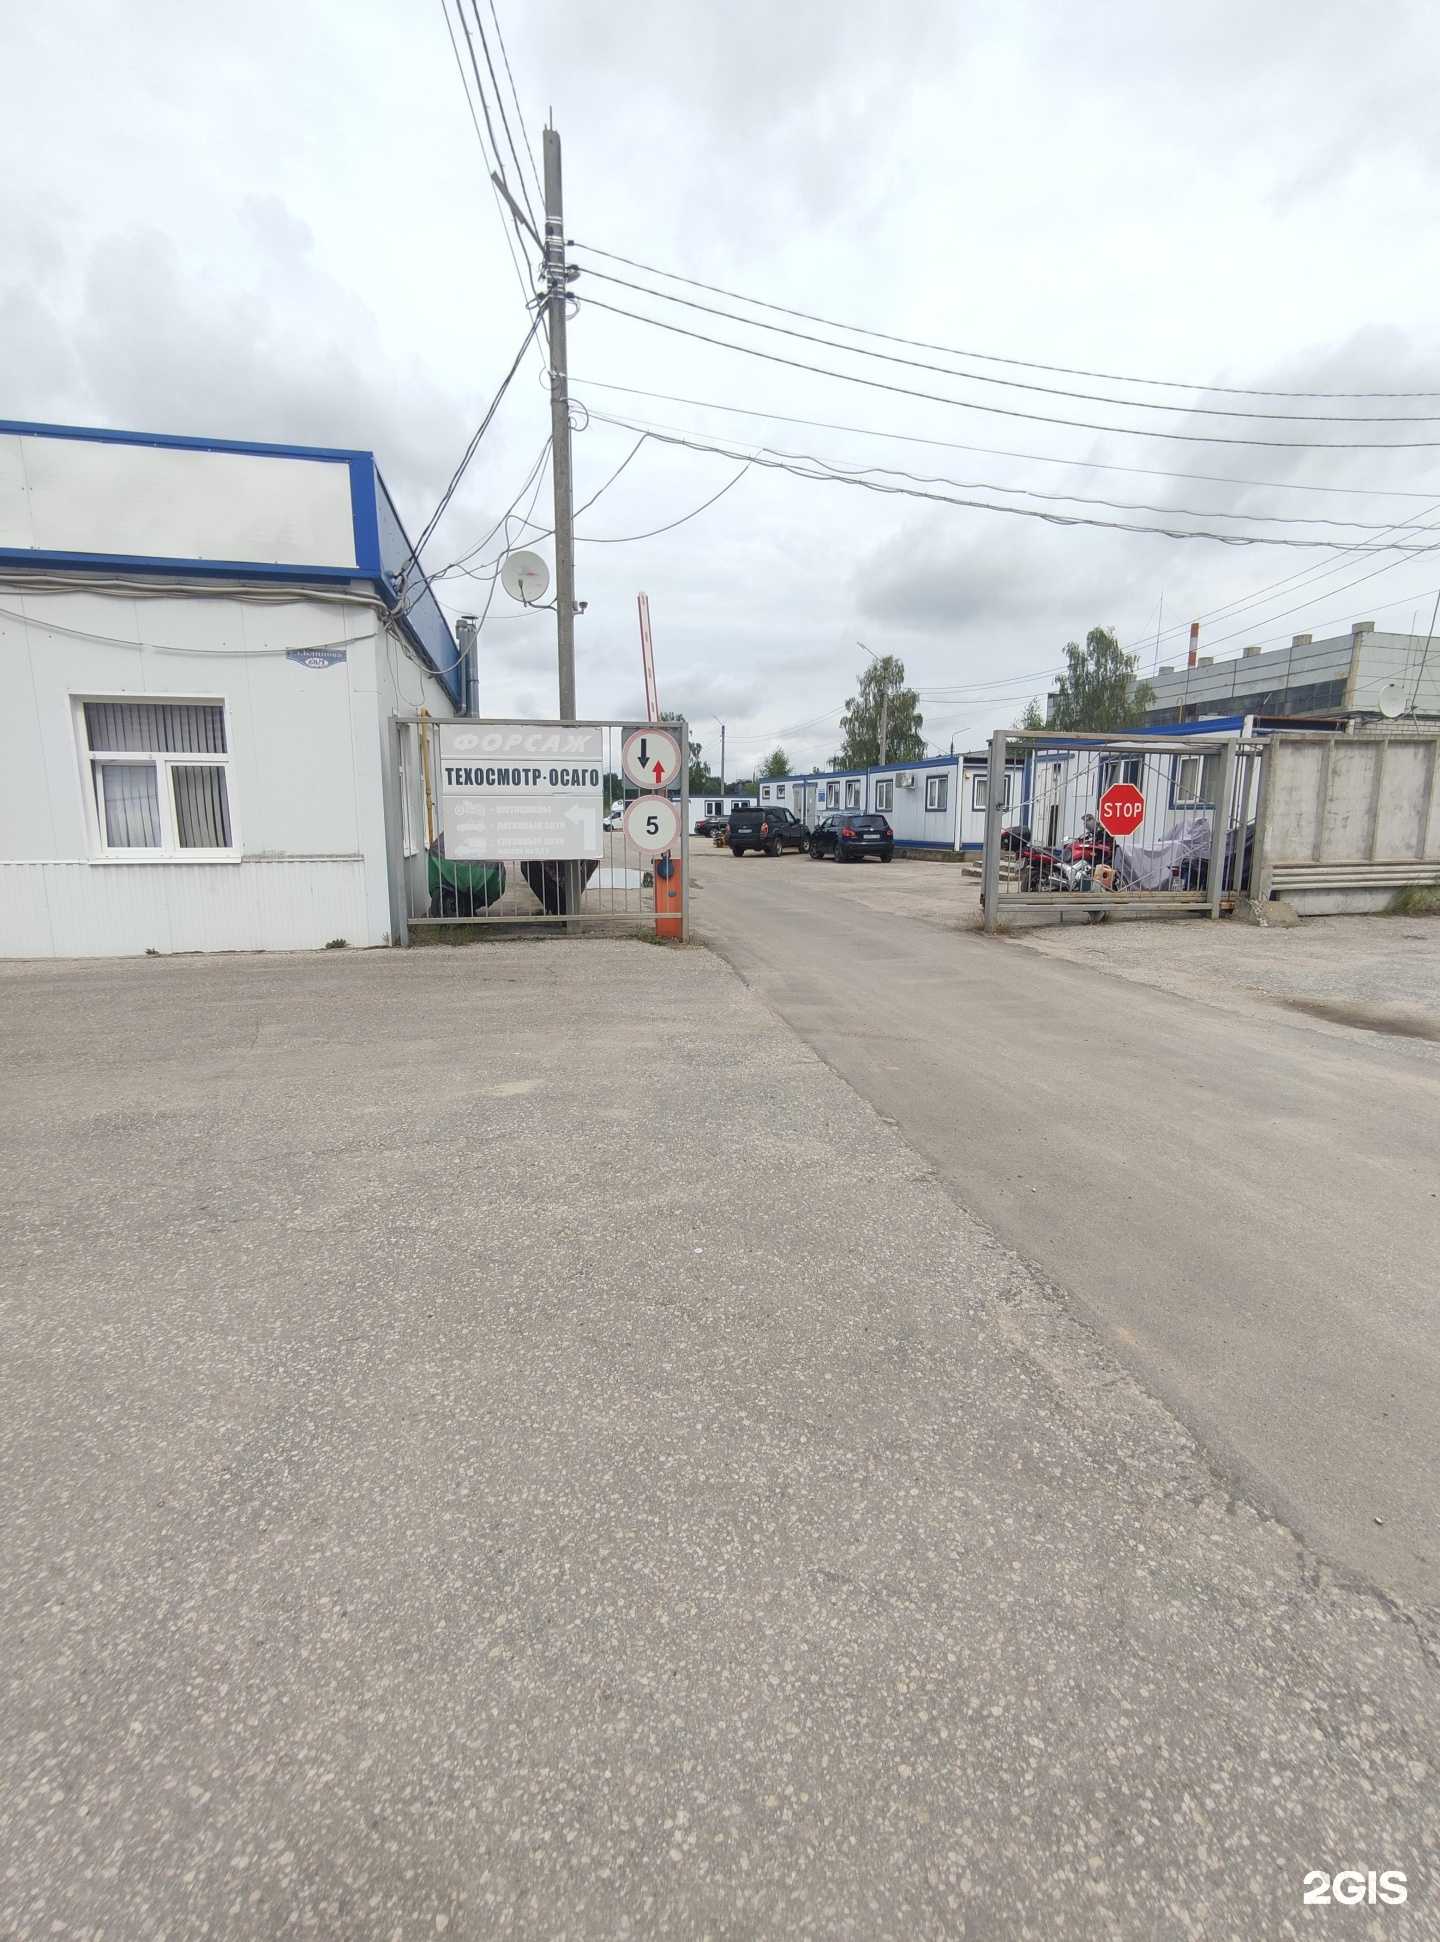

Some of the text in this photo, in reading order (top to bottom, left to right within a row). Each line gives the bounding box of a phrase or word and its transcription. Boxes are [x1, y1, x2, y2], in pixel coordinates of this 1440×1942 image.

[453, 733, 592, 752] ФОРСАЖ
[1103, 802, 1142, 818] STOP
[646, 815, 659, 835] 5
